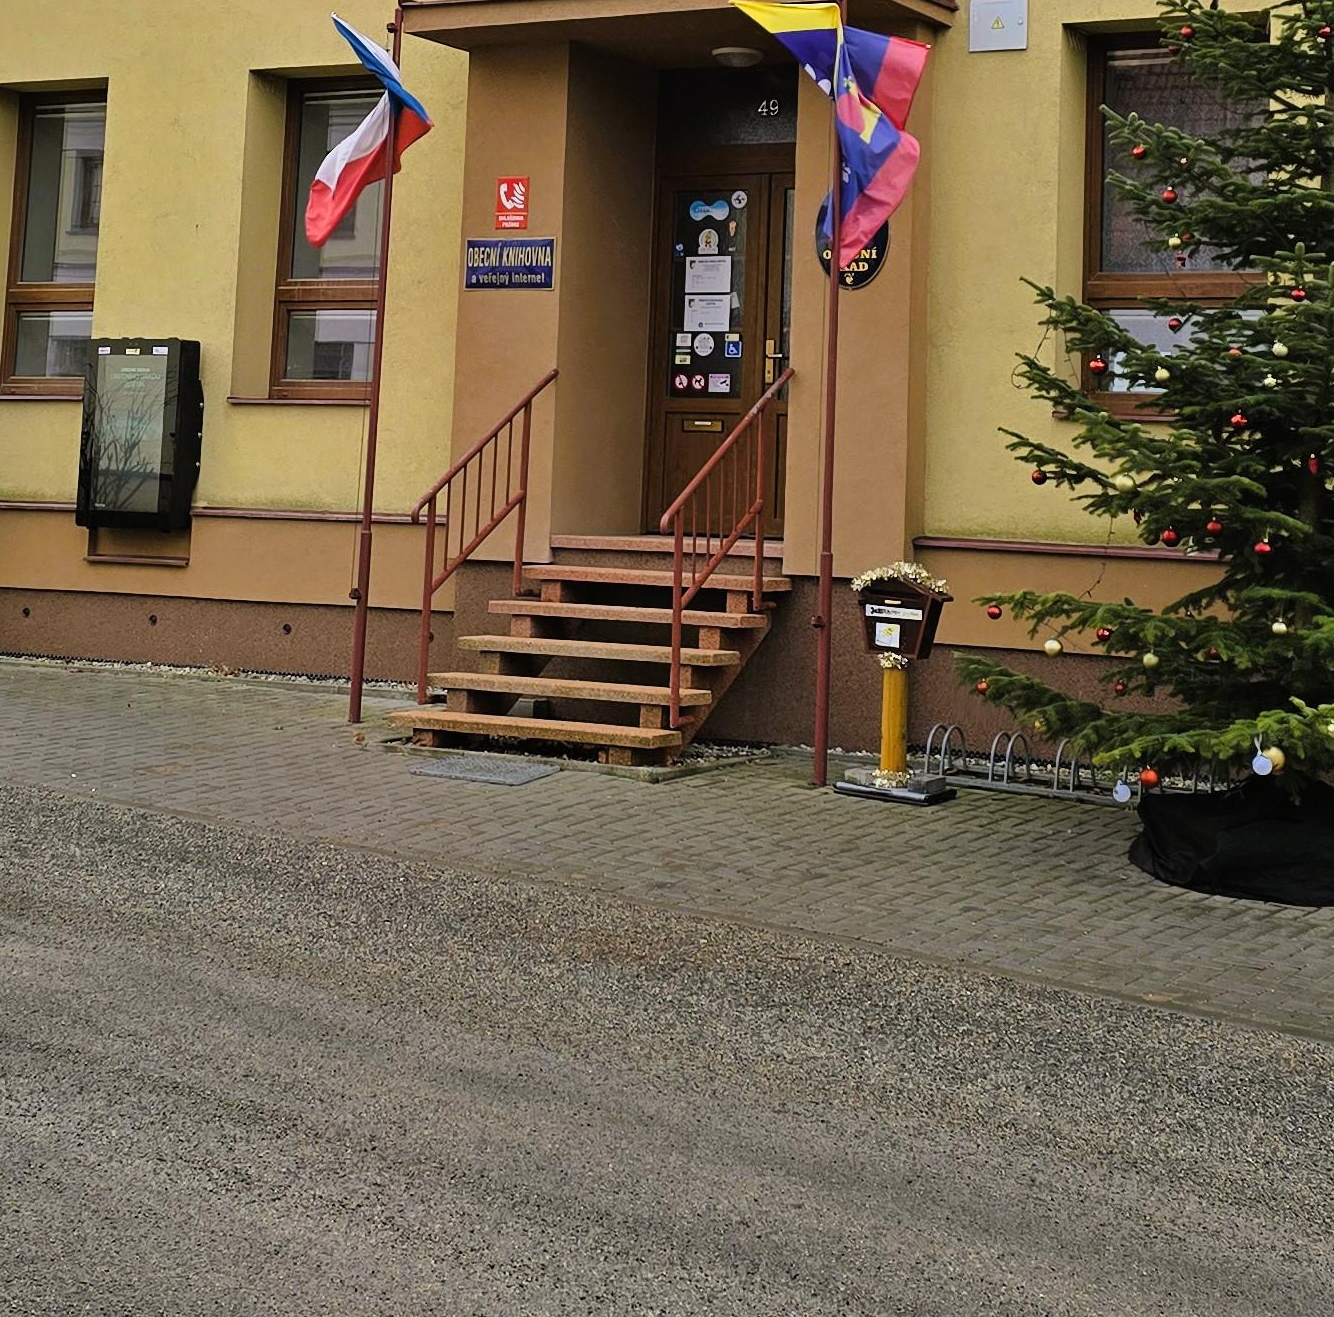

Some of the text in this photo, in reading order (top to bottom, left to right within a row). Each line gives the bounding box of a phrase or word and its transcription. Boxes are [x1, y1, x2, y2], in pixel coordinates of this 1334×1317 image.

[757, 99, 779, 116] 49
[467, 242, 552, 267] OBECNÍ KNIHOVNA
[471, 274, 476, 284] a
[479, 271, 509, 285] veřejný
